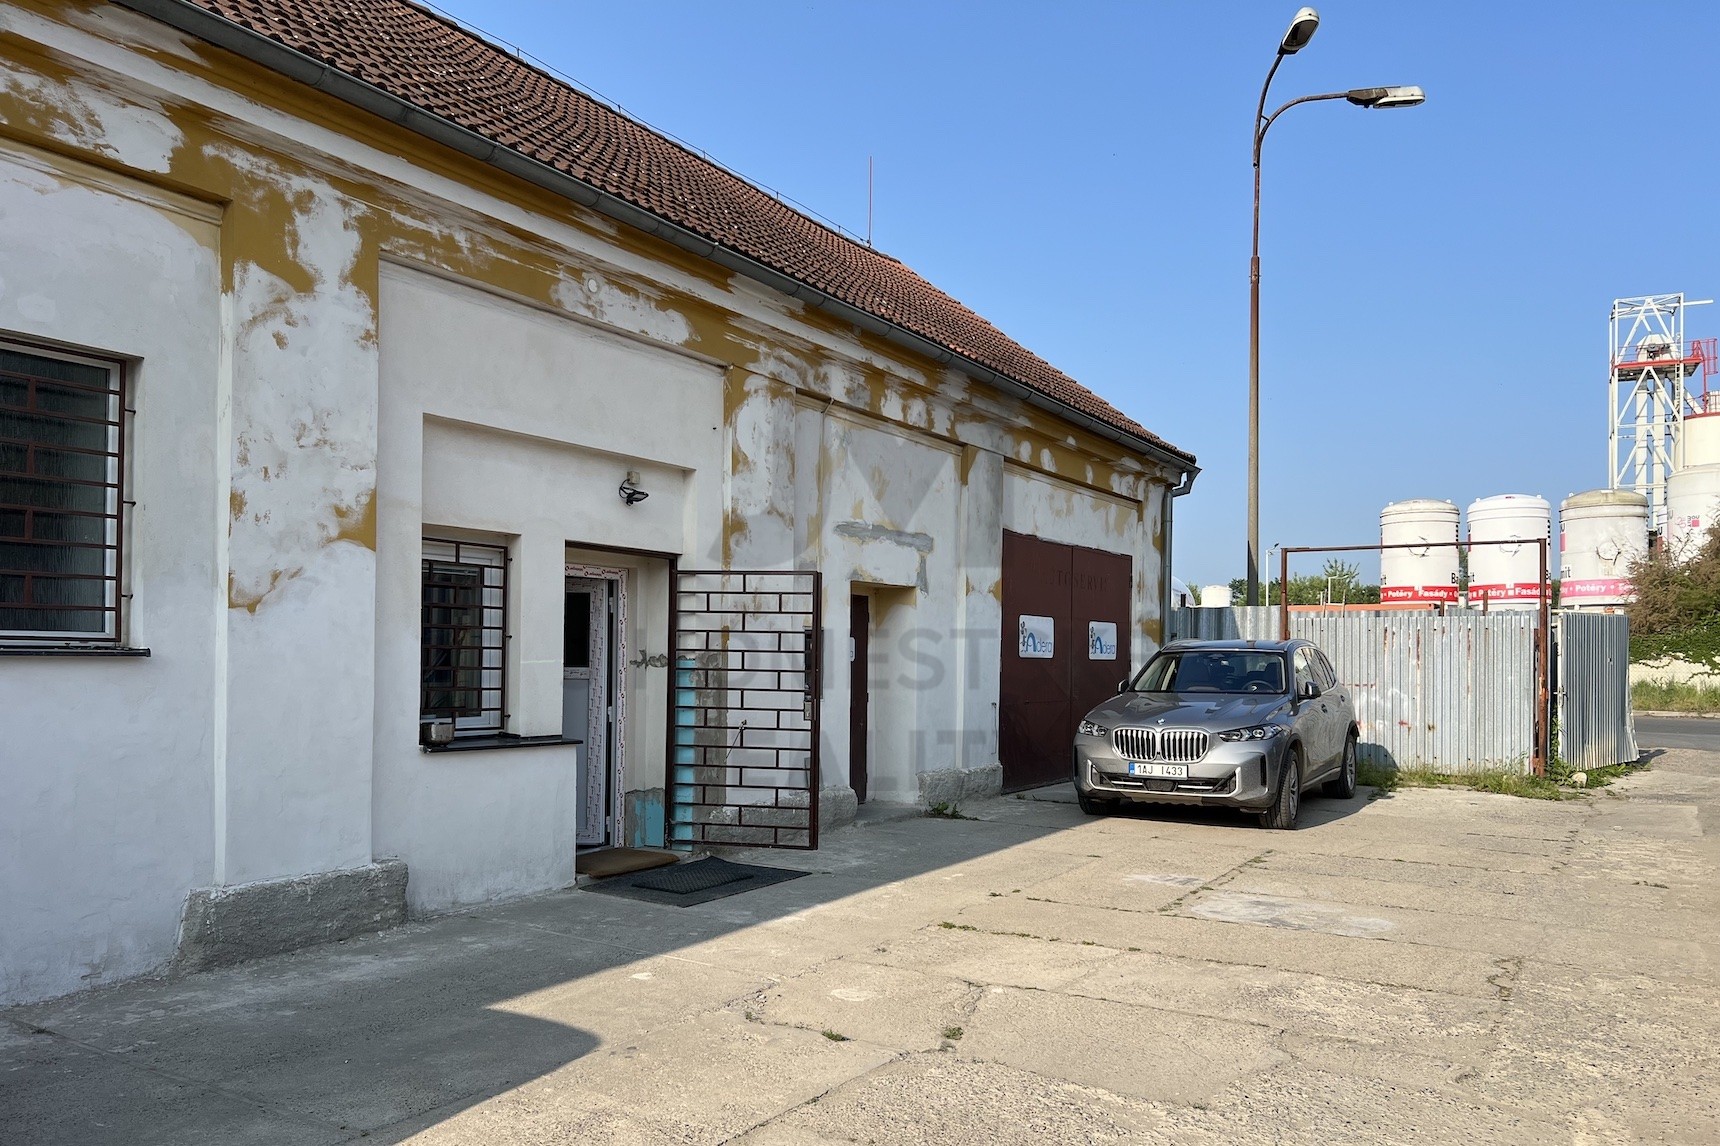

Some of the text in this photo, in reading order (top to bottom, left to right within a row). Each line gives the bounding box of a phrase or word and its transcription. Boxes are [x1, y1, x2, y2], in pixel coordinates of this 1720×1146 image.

[1478, 588, 1506, 598] Ptěry
[1515, 587, 1542, 596] Fasád
[1137, 764, 1154, 775] 1AJ
